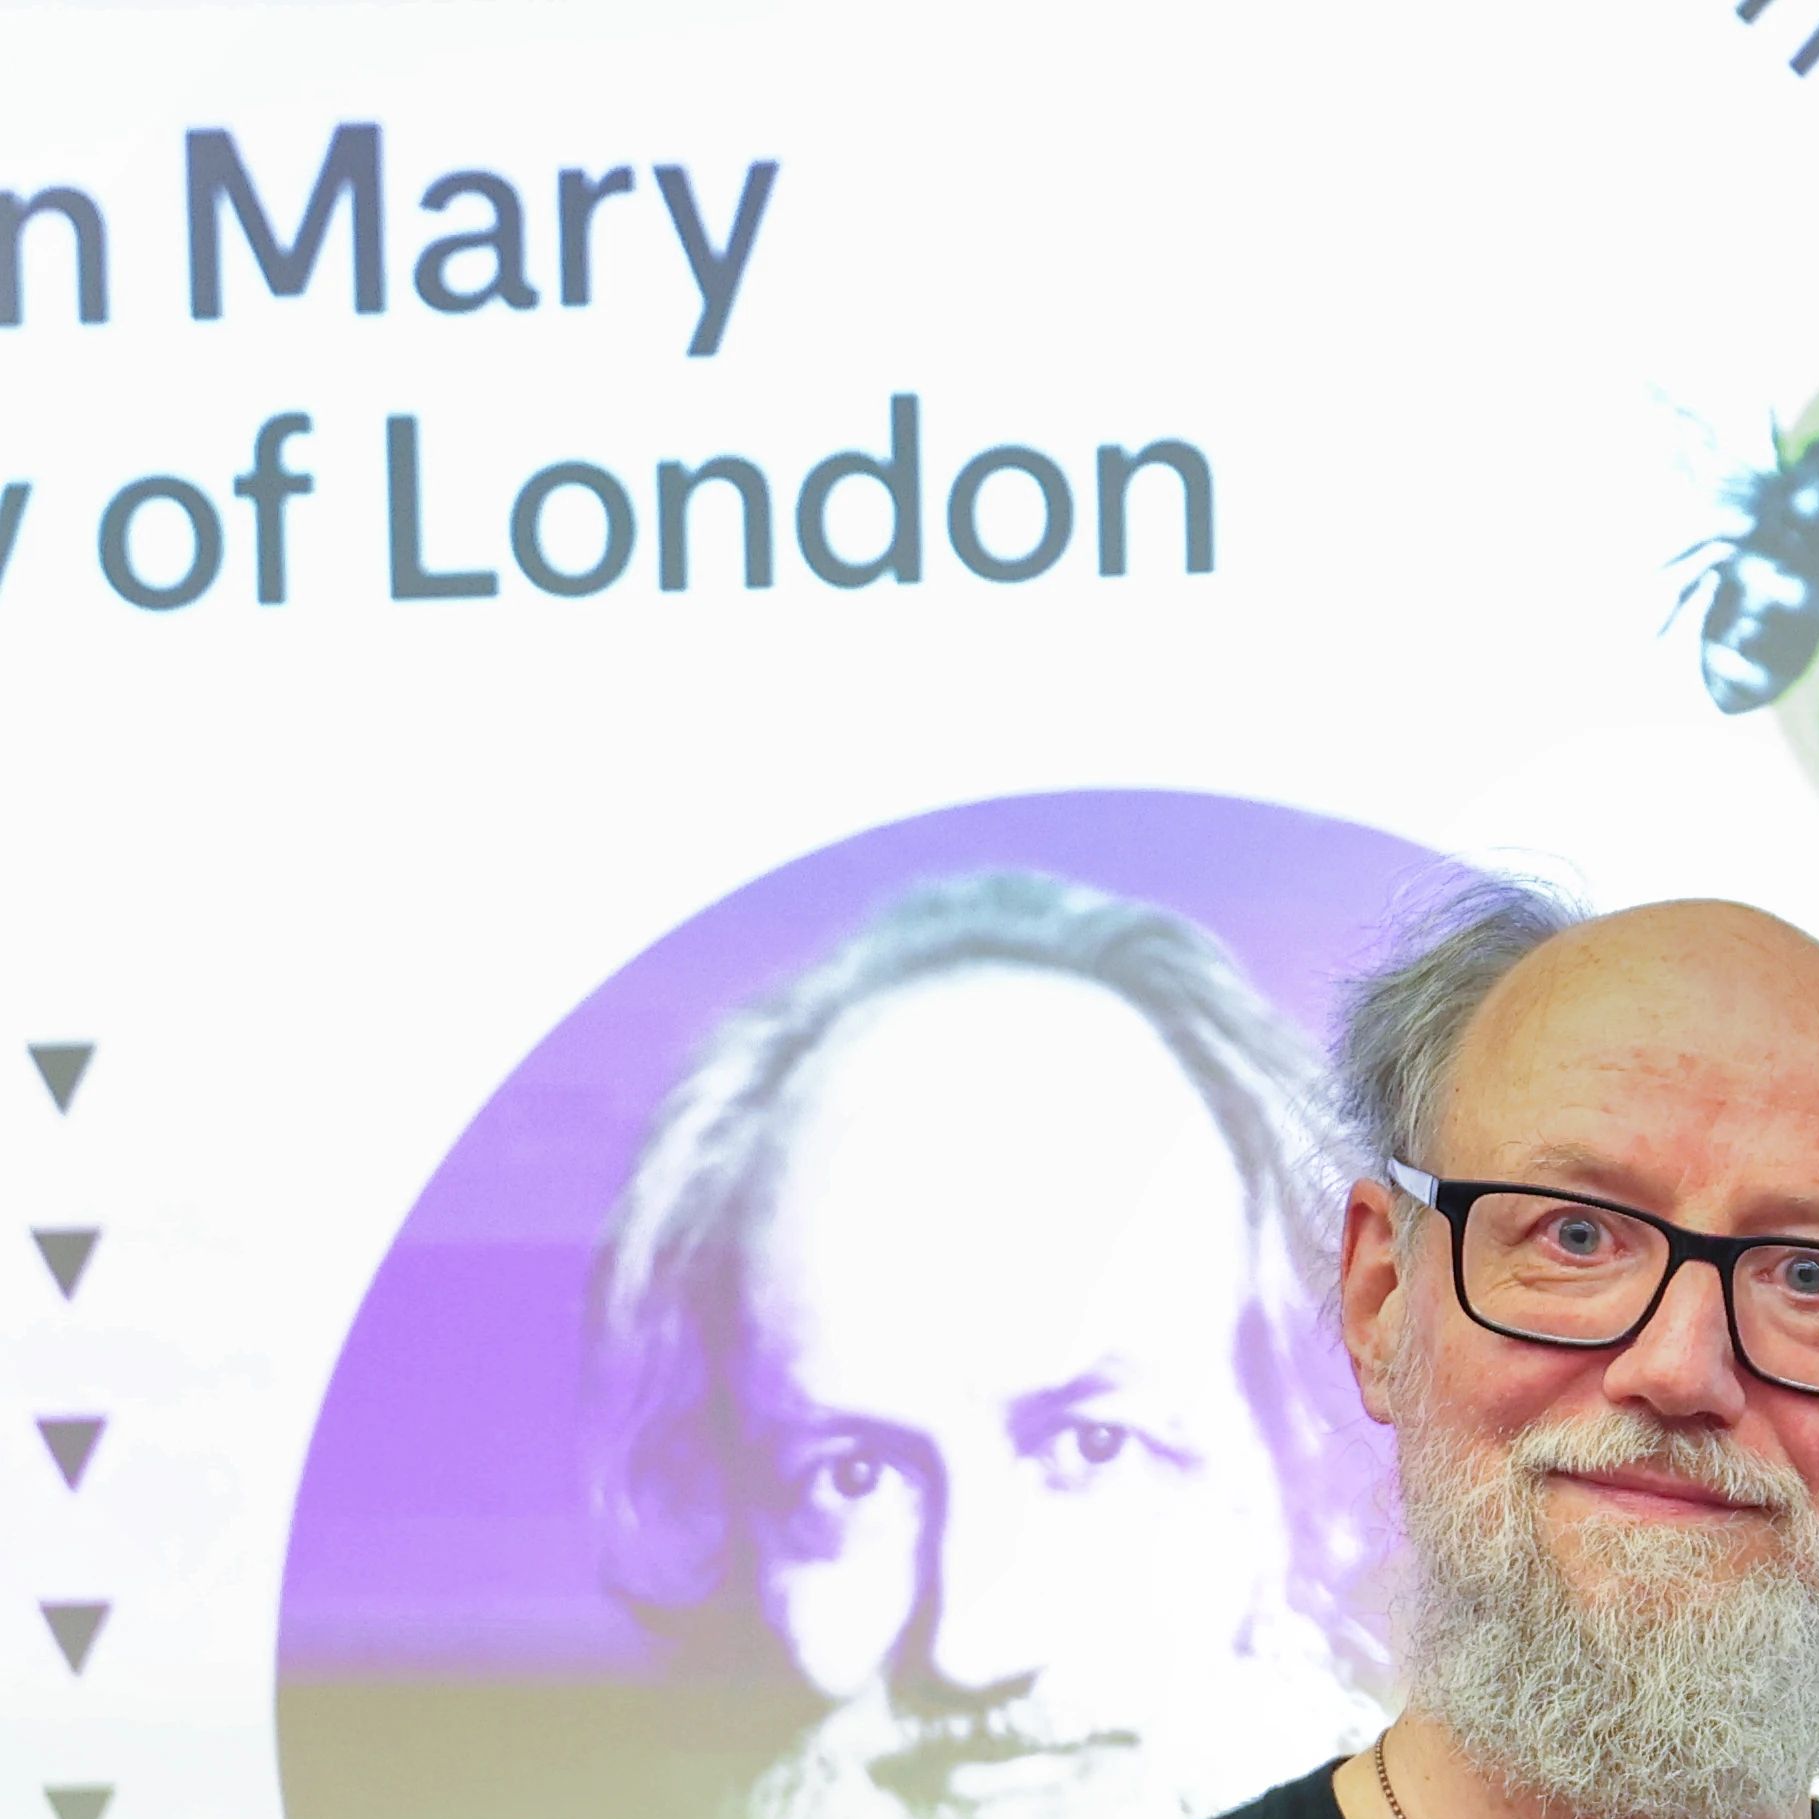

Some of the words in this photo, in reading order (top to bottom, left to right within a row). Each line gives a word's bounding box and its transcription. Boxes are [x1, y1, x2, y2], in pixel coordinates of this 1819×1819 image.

[184, 121, 781, 357] Mary
[97, 411, 314, 611] of
[385, 392, 1215, 600] London
